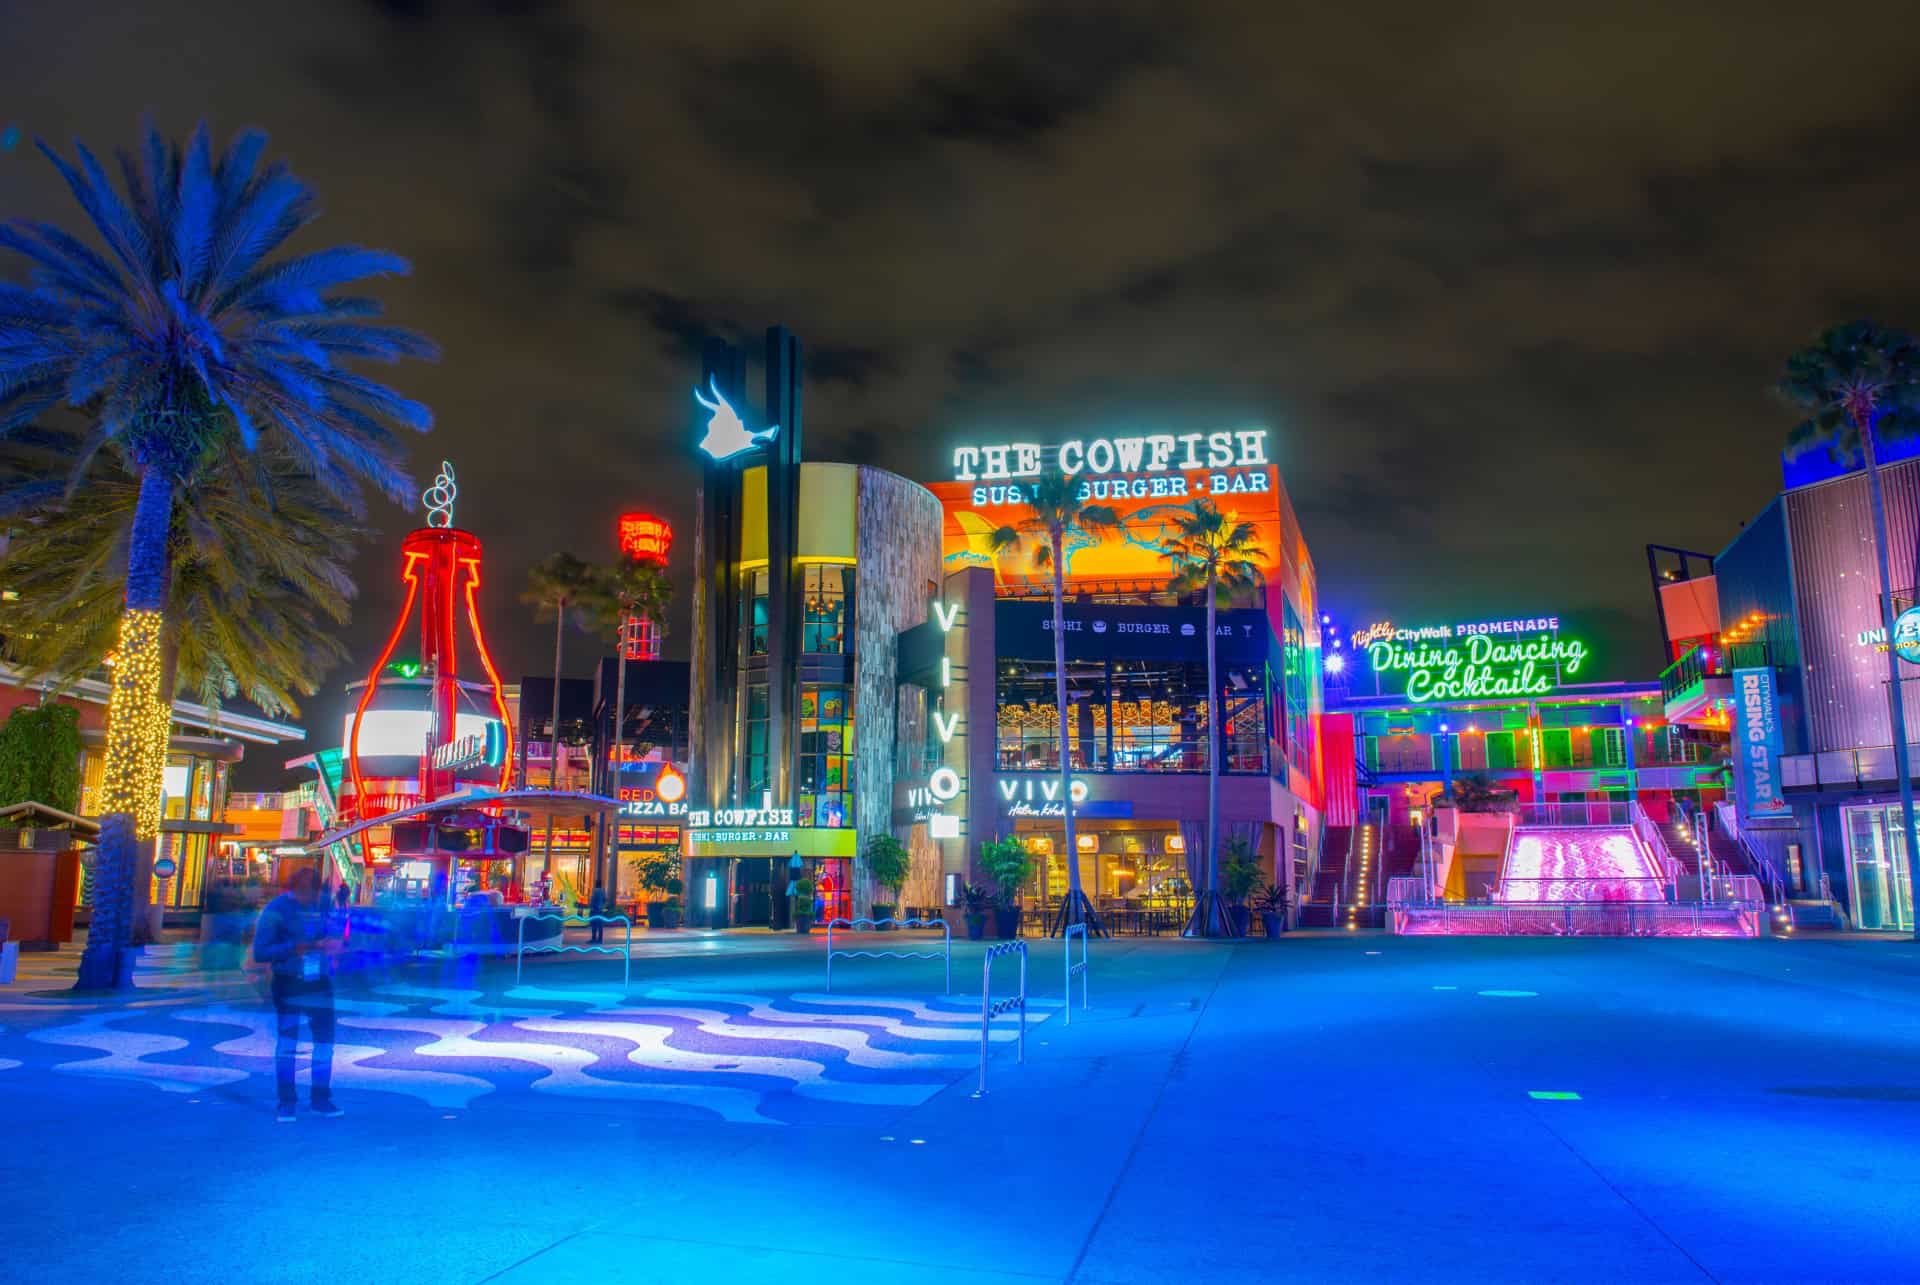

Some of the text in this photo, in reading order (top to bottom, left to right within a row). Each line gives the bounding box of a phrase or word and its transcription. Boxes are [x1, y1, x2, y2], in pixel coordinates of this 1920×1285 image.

[953, 430, 1269, 481] THE COWFISH
[1076, 477, 1189, 501] BURGER
[1209, 472, 1270, 495] BAR
[1117, 622, 1171, 634] BURGER
[1215, 625, 1233, 636] AR
[1351, 617, 1560, 649] Nightly CityWalk PROMENADE
[1369, 633, 1589, 681] Dining Dancing
[1406, 661, 1552, 703] Cocktails
[930, 601, 961, 800] VIVO
[1742, 674, 1773, 799] RISING STAR
[619, 788, 655, 801] RED
[907, 786, 945, 808] VIV
[714, 808, 793, 826] COWFISH
[716, 832, 757, 842] BURGER
[764, 831, 790, 841] BAR
